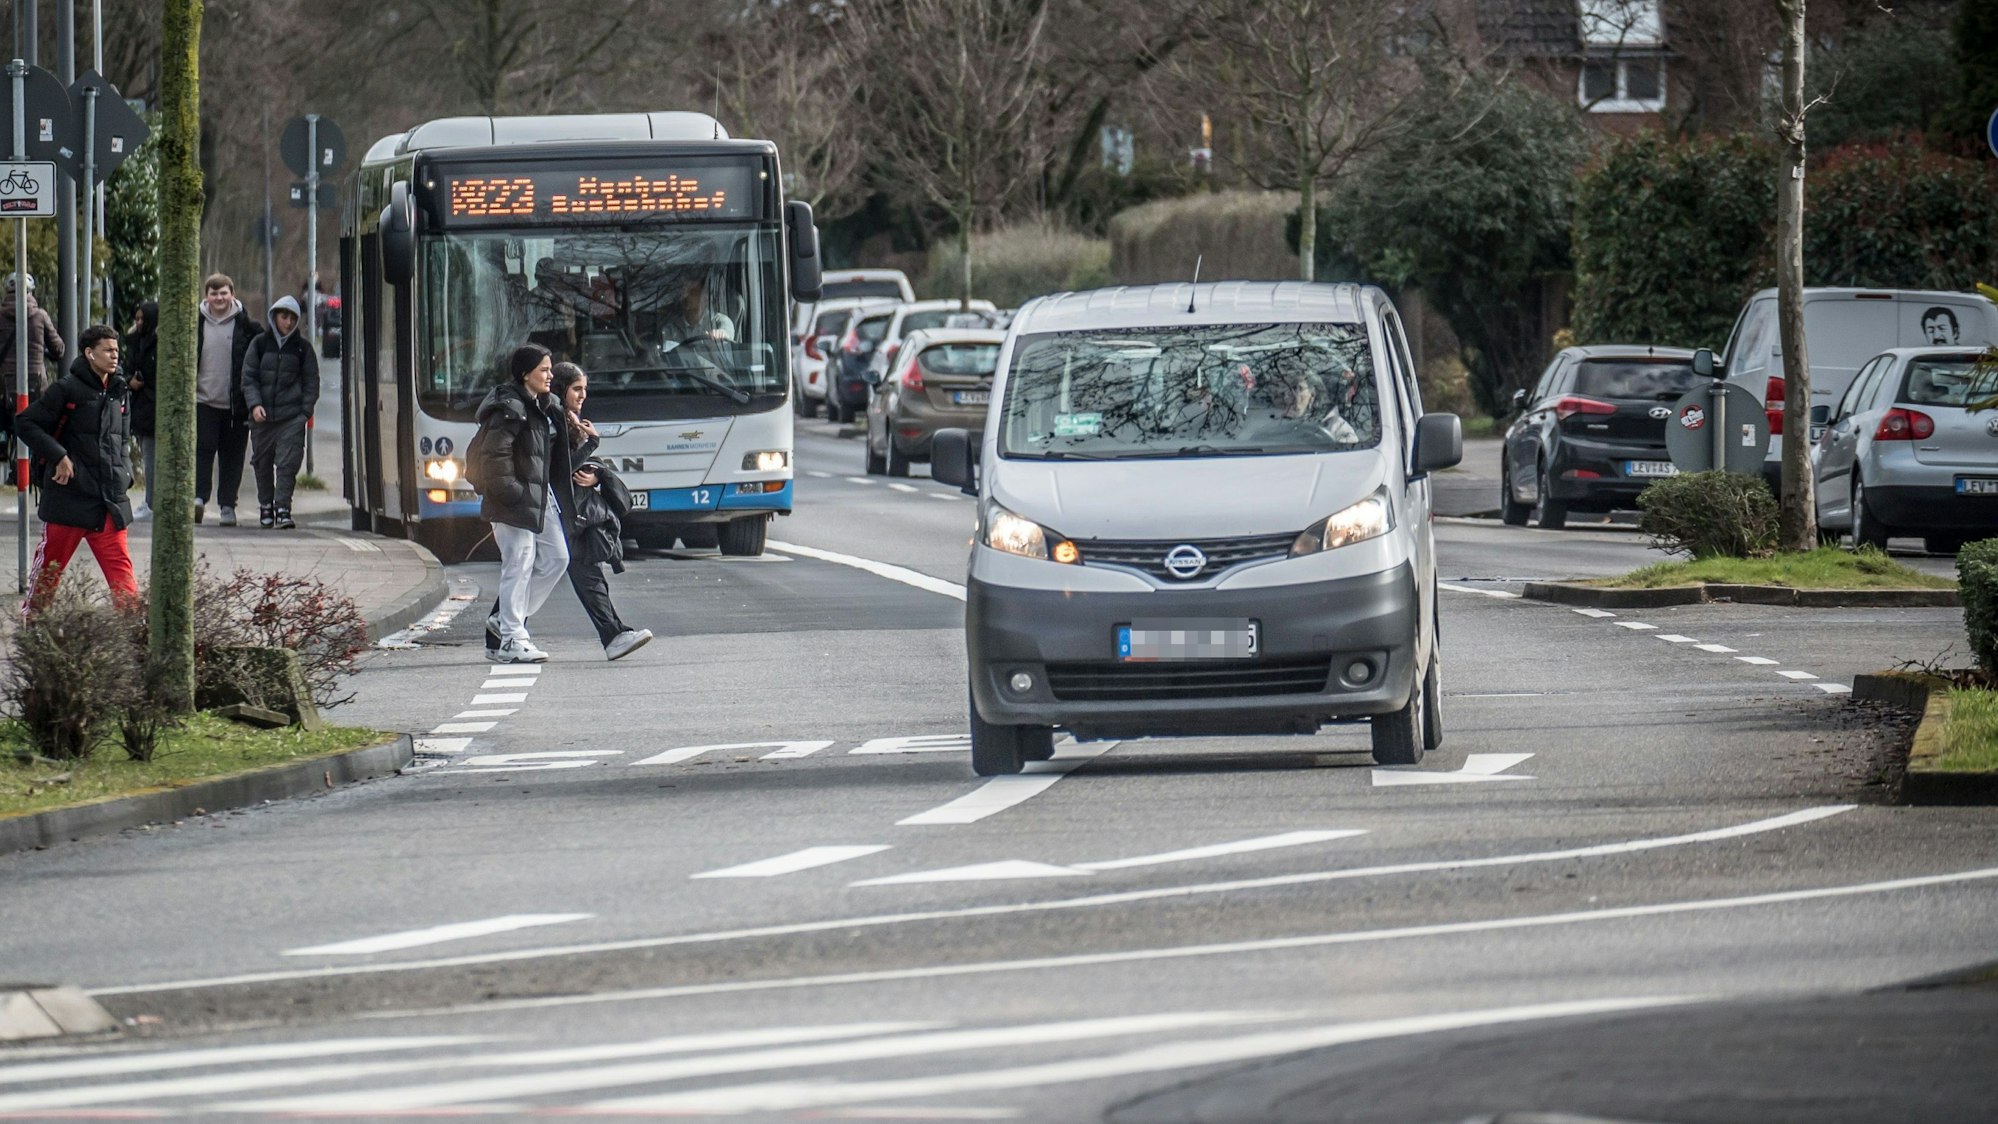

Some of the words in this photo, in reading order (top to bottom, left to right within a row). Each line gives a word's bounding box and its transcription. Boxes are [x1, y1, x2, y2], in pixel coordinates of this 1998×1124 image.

[1632, 463, 1650, 473] LEV
[1658, 463, 1670, 473] AS
[1963, 480, 1985, 493] LEV
[691, 490, 710, 504] 12
[1169, 558, 1201, 566] NISSAN
